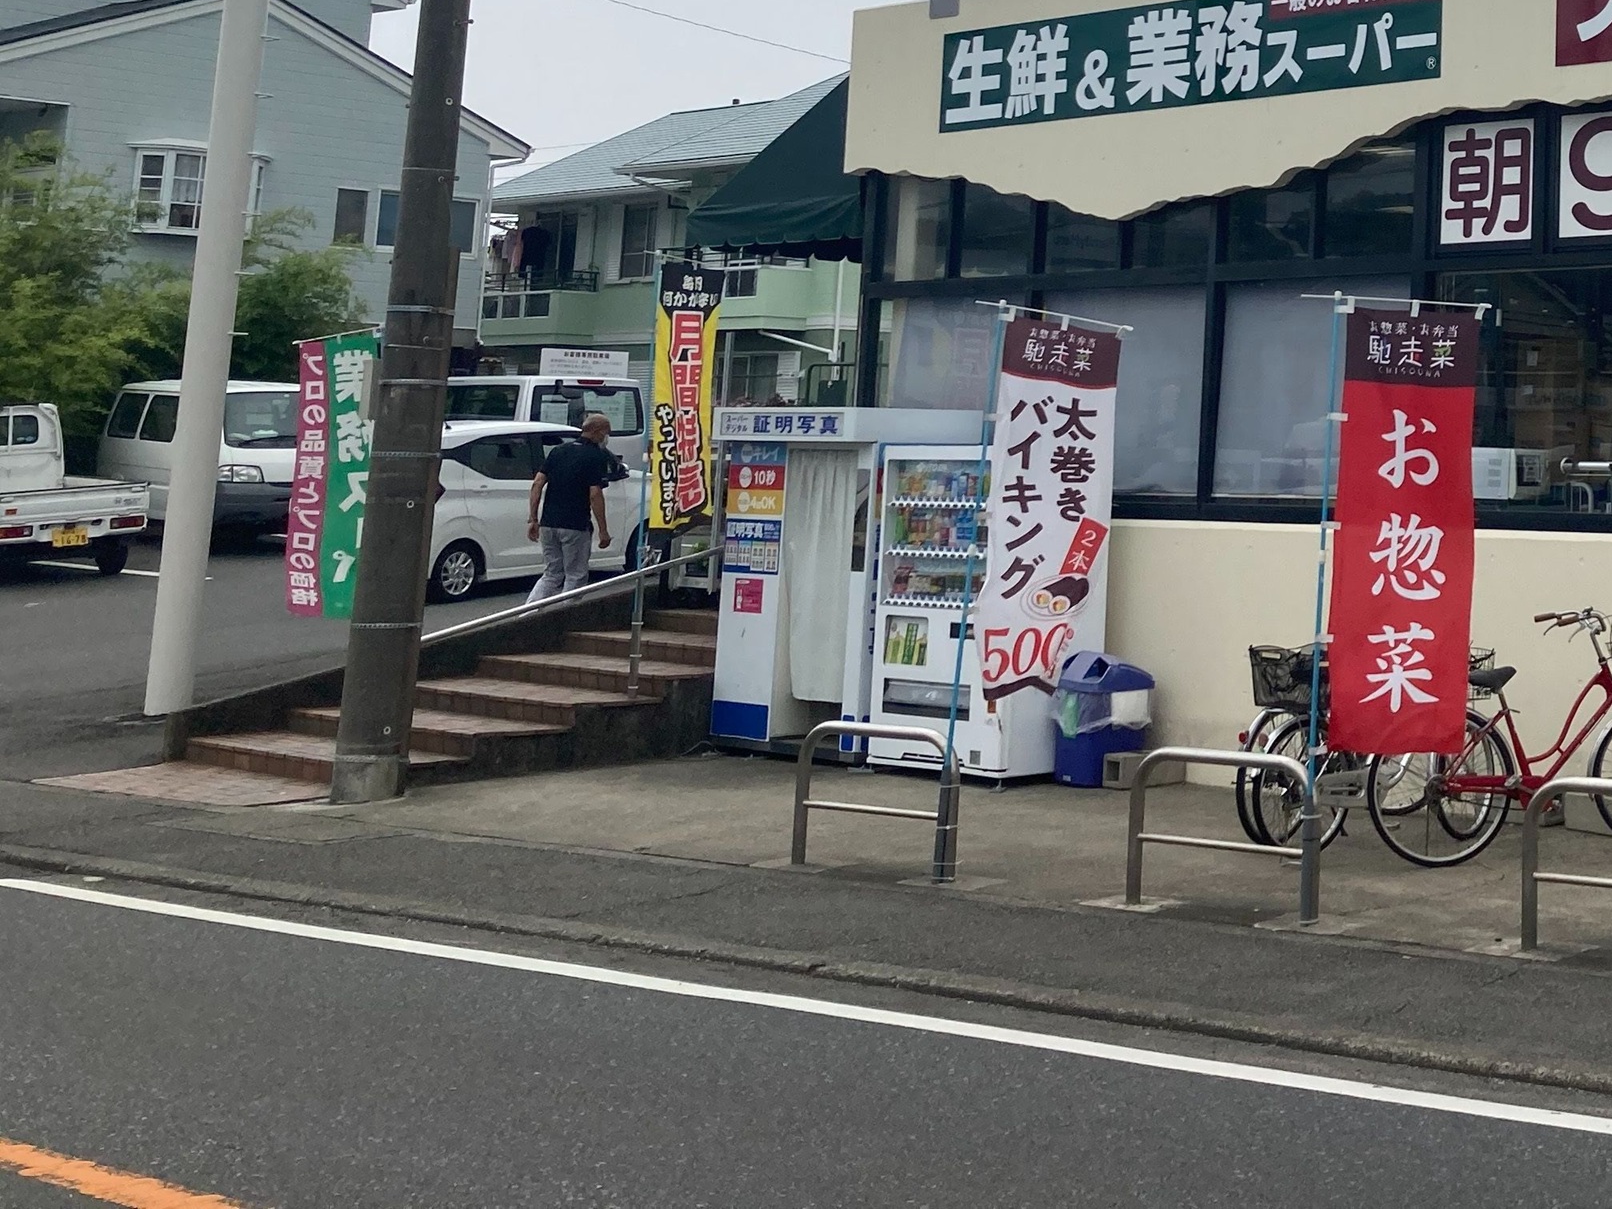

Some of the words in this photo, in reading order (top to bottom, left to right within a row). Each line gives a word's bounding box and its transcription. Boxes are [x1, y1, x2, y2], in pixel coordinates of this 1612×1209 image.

[1022, 339, 1093, 371] 馳走菜
[1367, 335, 1456, 369] 馳走菜
[753, 415, 839, 435] 証明写真
[754, 470, 776, 486] 10秒
[1050, 398, 1097, 522] 太巻き
[1001, 396, 1054, 599] バイキング
[1068, 530, 1097, 570] 2本
[1359, 409, 1446, 713] お惣菜
